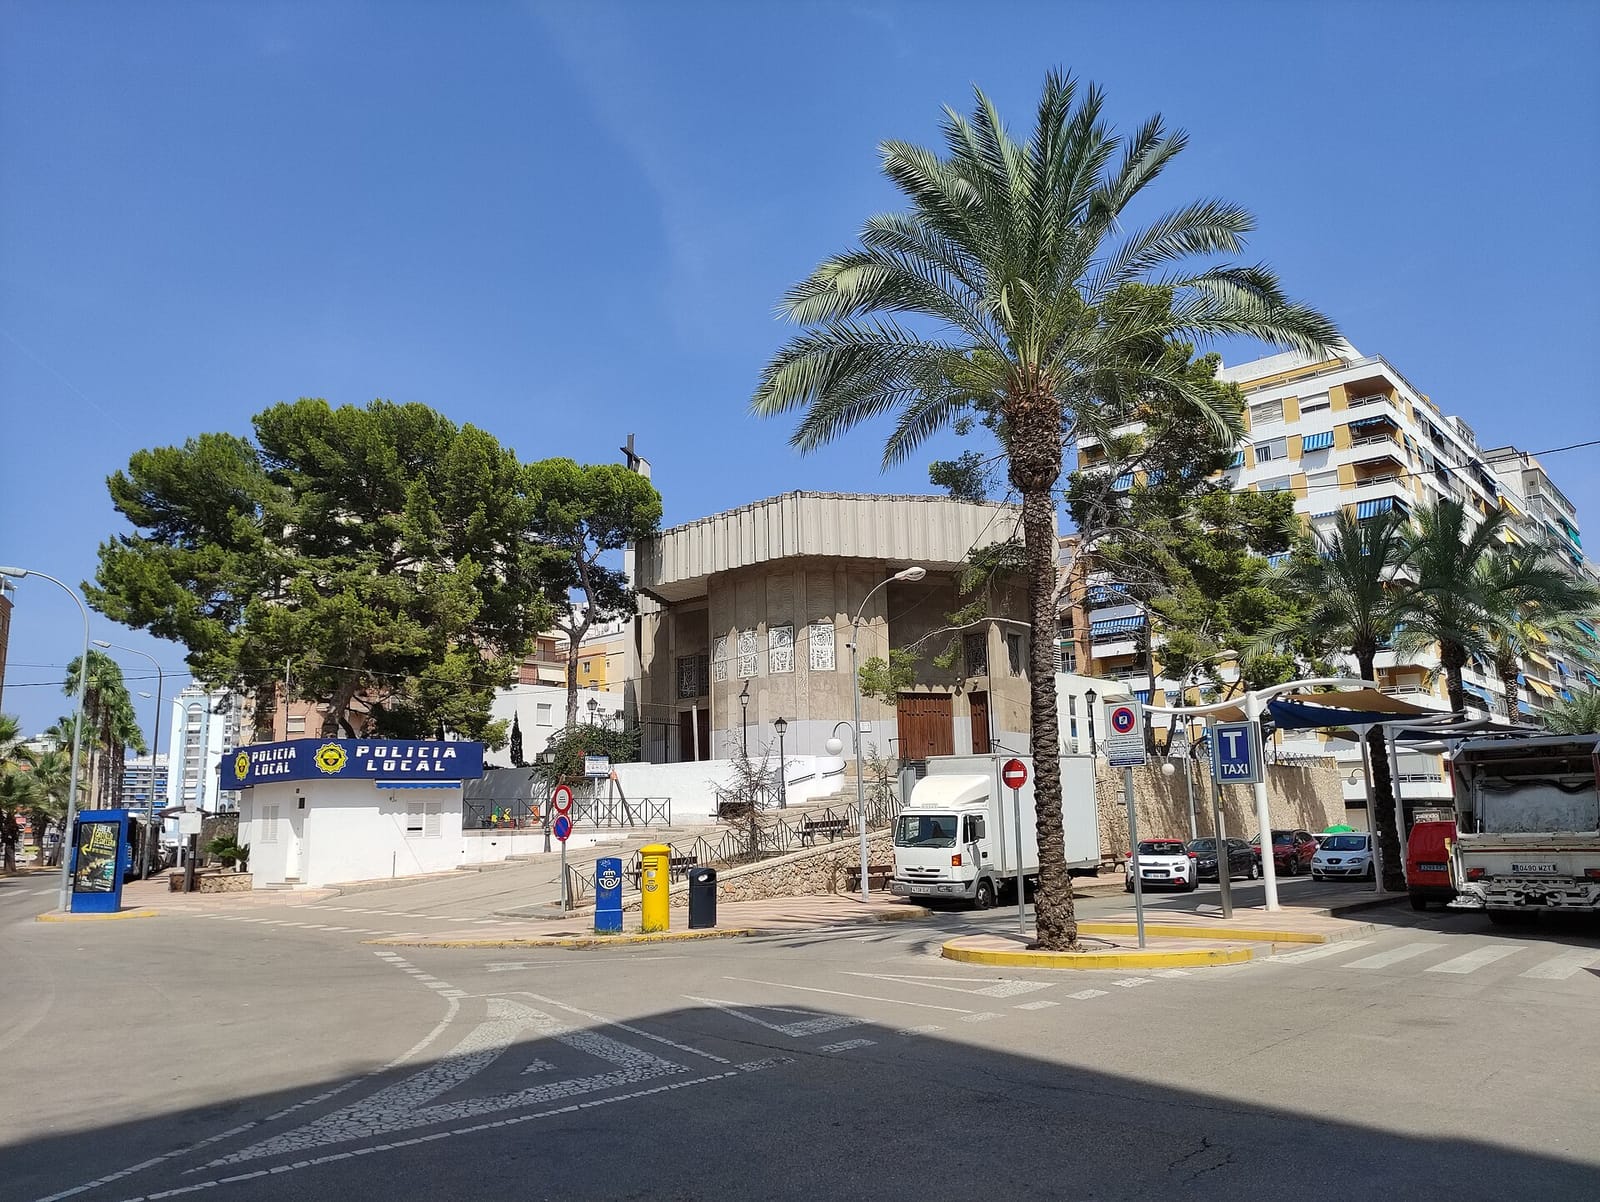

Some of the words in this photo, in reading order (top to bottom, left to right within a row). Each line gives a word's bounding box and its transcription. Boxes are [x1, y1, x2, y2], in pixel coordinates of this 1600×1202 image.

[355, 745, 457, 758] POLICIA
[1222, 731, 1243, 759] T
[251, 747, 296, 764] POLICIA
[254, 761, 291, 776] LOCAL
[366, 759, 446, 772] LOCAL
[1221, 763, 1249, 775] TAXI
